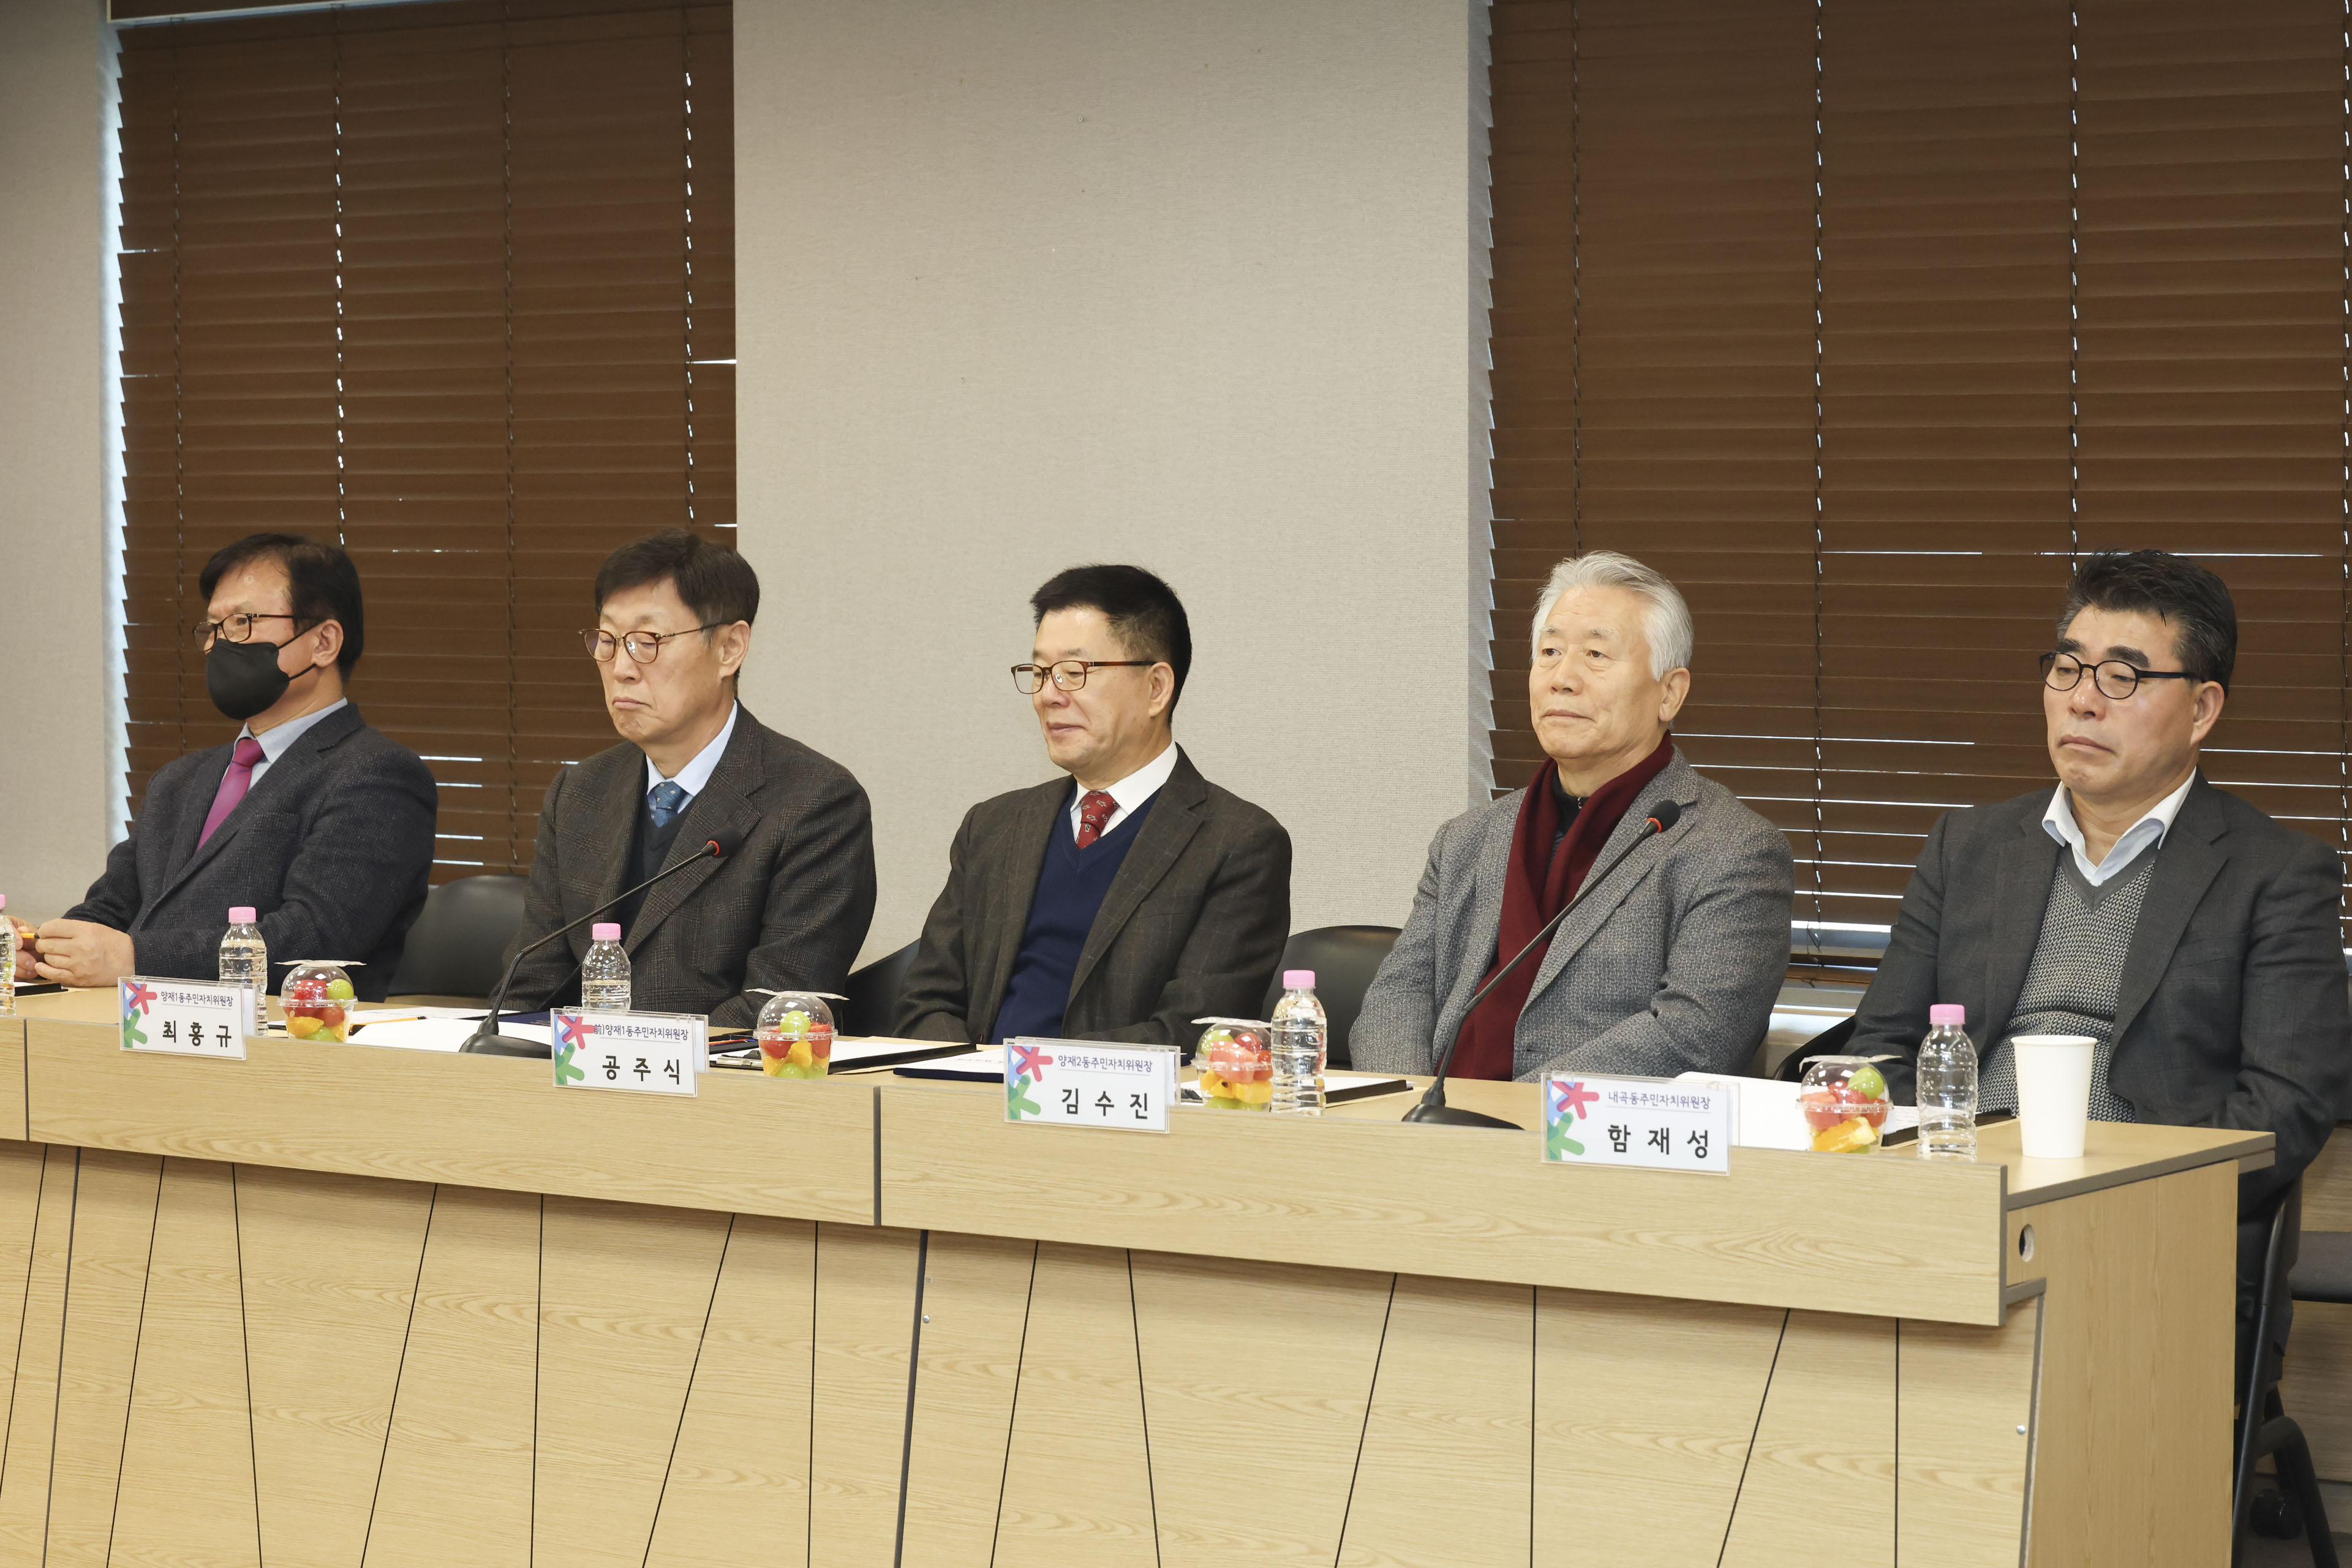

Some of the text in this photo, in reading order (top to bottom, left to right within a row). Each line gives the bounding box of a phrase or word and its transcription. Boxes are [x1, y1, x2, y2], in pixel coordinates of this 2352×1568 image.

[160, 990, 233, 1008] 양재1동주민자치위원장
[1058, 1054, 1153, 1073] 양재2동주민자치위원장
[1608, 1091, 1711, 1110] 내곡동주민자치위원장
